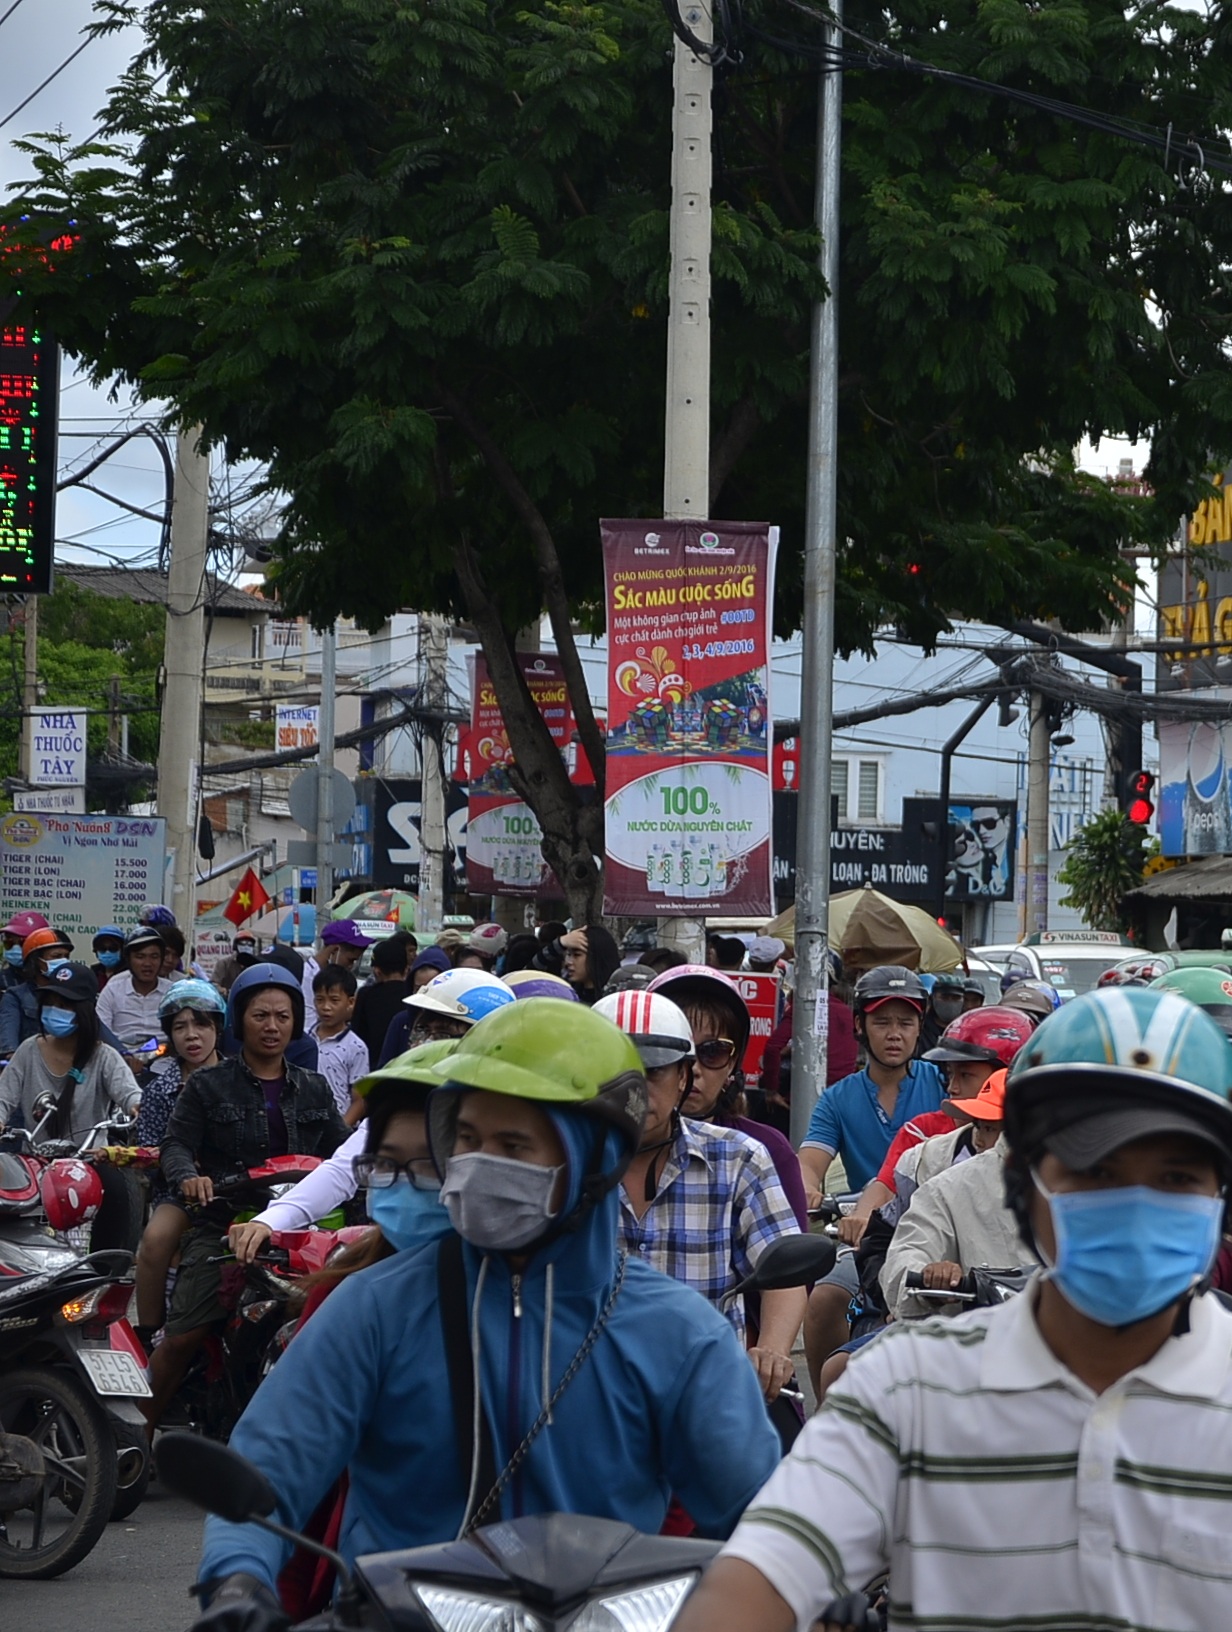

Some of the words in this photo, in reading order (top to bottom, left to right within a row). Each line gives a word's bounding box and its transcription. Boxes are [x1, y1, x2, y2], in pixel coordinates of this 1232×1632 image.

[613, 570, 636, 582] CHÀO
[637, 568, 664, 580] MỪNG
[688, 565, 718, 576] KHÁNH
[719, 563, 757, 576] 2/9/2016
[613, 584, 643, 610] SẮC
[645, 584, 676, 607] MÀU
[679, 583, 712, 605] CUỘC
[714, 575, 755, 599] SỐNG
[614, 616, 631, 629] Một
[632, 612, 659, 627] không
[660, 612, 679, 627] gian
[699, 607, 716, 620] ảnh
[614, 632, 630, 644] cực
[631, 628, 650, 642] chất
[651, 627, 672, 640] dành
[688, 624, 705, 638] giới
[705, 622, 718, 635] trẻ
[279, 708, 317, 721] INTERNET
[34, 731, 83, 752] THUỐC
[40, 756, 75, 775] TÂY
[1136, 774, 1147, 791] 2
[660, 786, 721, 815] 100%
[627, 820, 658, 832] NƯỚC
[659, 819, 683, 832] DỪA
[684, 820, 724, 832] NGUYÊN
[725, 820, 753, 832] CHẤT
[74, 836, 98, 848] Ngon
[2, 854, 31, 863] TIGER
[34, 855, 65, 865] (CHAI)
[115, 858, 148, 867] 15.500
[2, 865, 31, 875] TIGER
[34, 867, 61, 877] (LON)
[114, 870, 147, 879] 17.000
[832, 862, 862, 885] LOẠN
[871, 864, 888, 882] ĐA
[889, 860, 928, 884] TRÒNG
[2, 877, 31, 886] TIGER
[33, 878, 54, 889] BẠC
[56, 879, 86, 889] (CHAI)
[114, 881, 147, 890] 16.000
[1, 888, 30, 898] TIGER
[33, 890, 54, 901] BẠC
[56, 891, 82, 900] (LON)
[113, 892, 146, 902] 20.000
[1, 900, 50, 910] HEINEKEN
[112, 904, 140, 913] 22.00
[53, 914, 82, 923] (CHAI)
[98, 1373, 143, 1393] 6546
